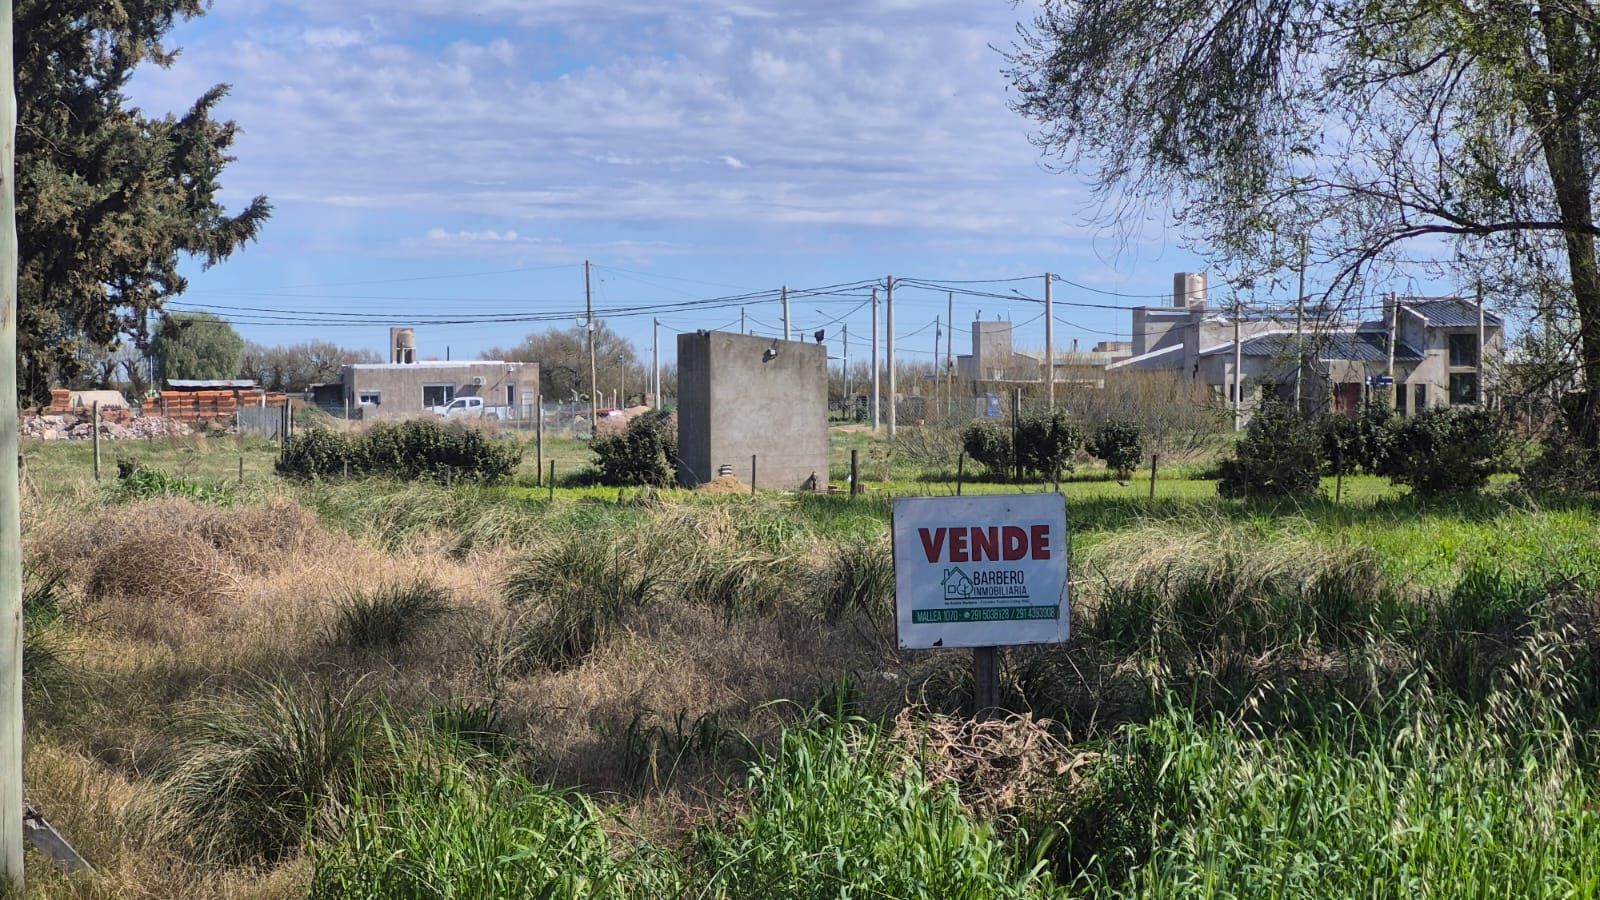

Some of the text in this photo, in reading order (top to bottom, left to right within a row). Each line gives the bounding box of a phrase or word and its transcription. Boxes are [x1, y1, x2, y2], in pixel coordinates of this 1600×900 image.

[918, 525, 1051, 563] VENDE
[973, 570, 1024, 585] BARBERO
[973, 585, 1028, 597] INMOBILIARIA
[917, 610, 942, 622] MALLEA
[1015, 607, 1027, 619] 291
